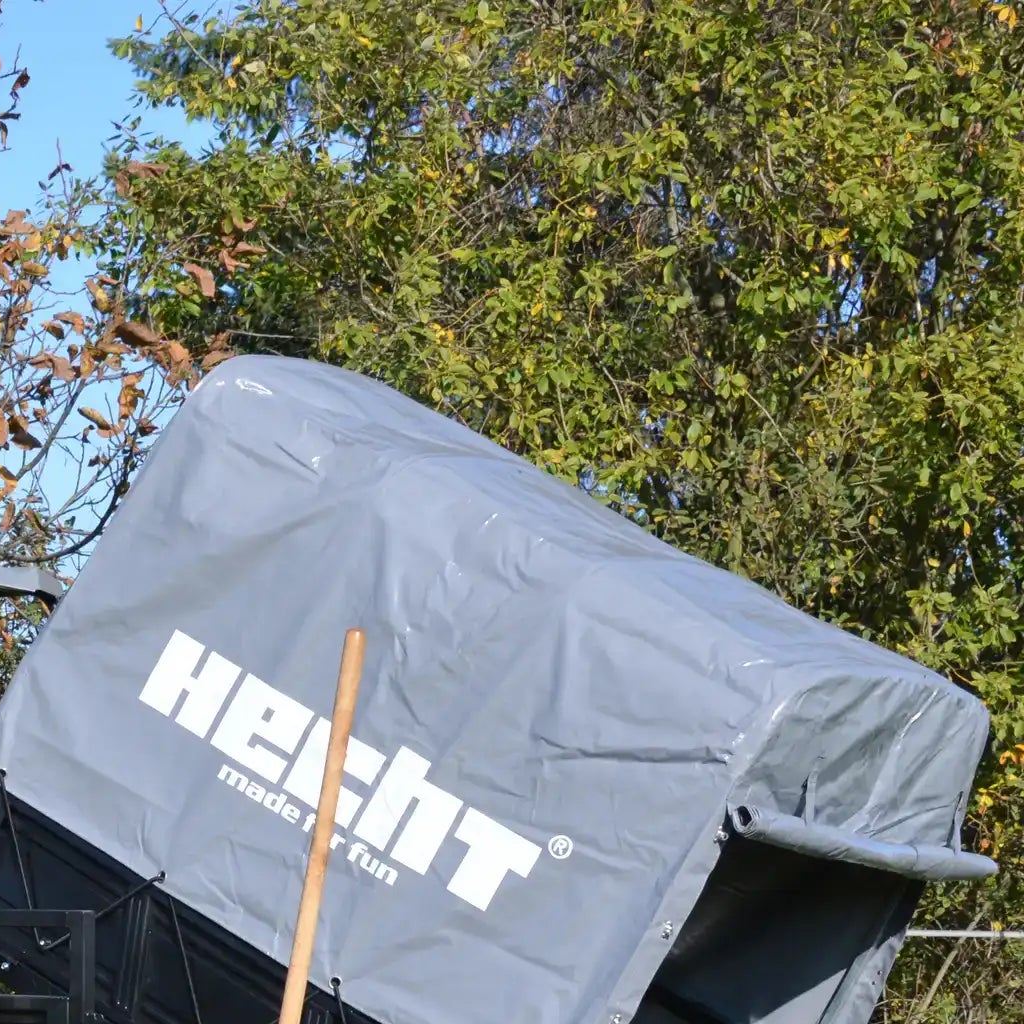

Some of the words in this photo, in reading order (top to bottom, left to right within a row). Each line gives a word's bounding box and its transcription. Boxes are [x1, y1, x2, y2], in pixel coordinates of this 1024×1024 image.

[217, 764, 301, 824] made
[302, 812, 346, 850] fr
[346, 842, 398, 886] fun
